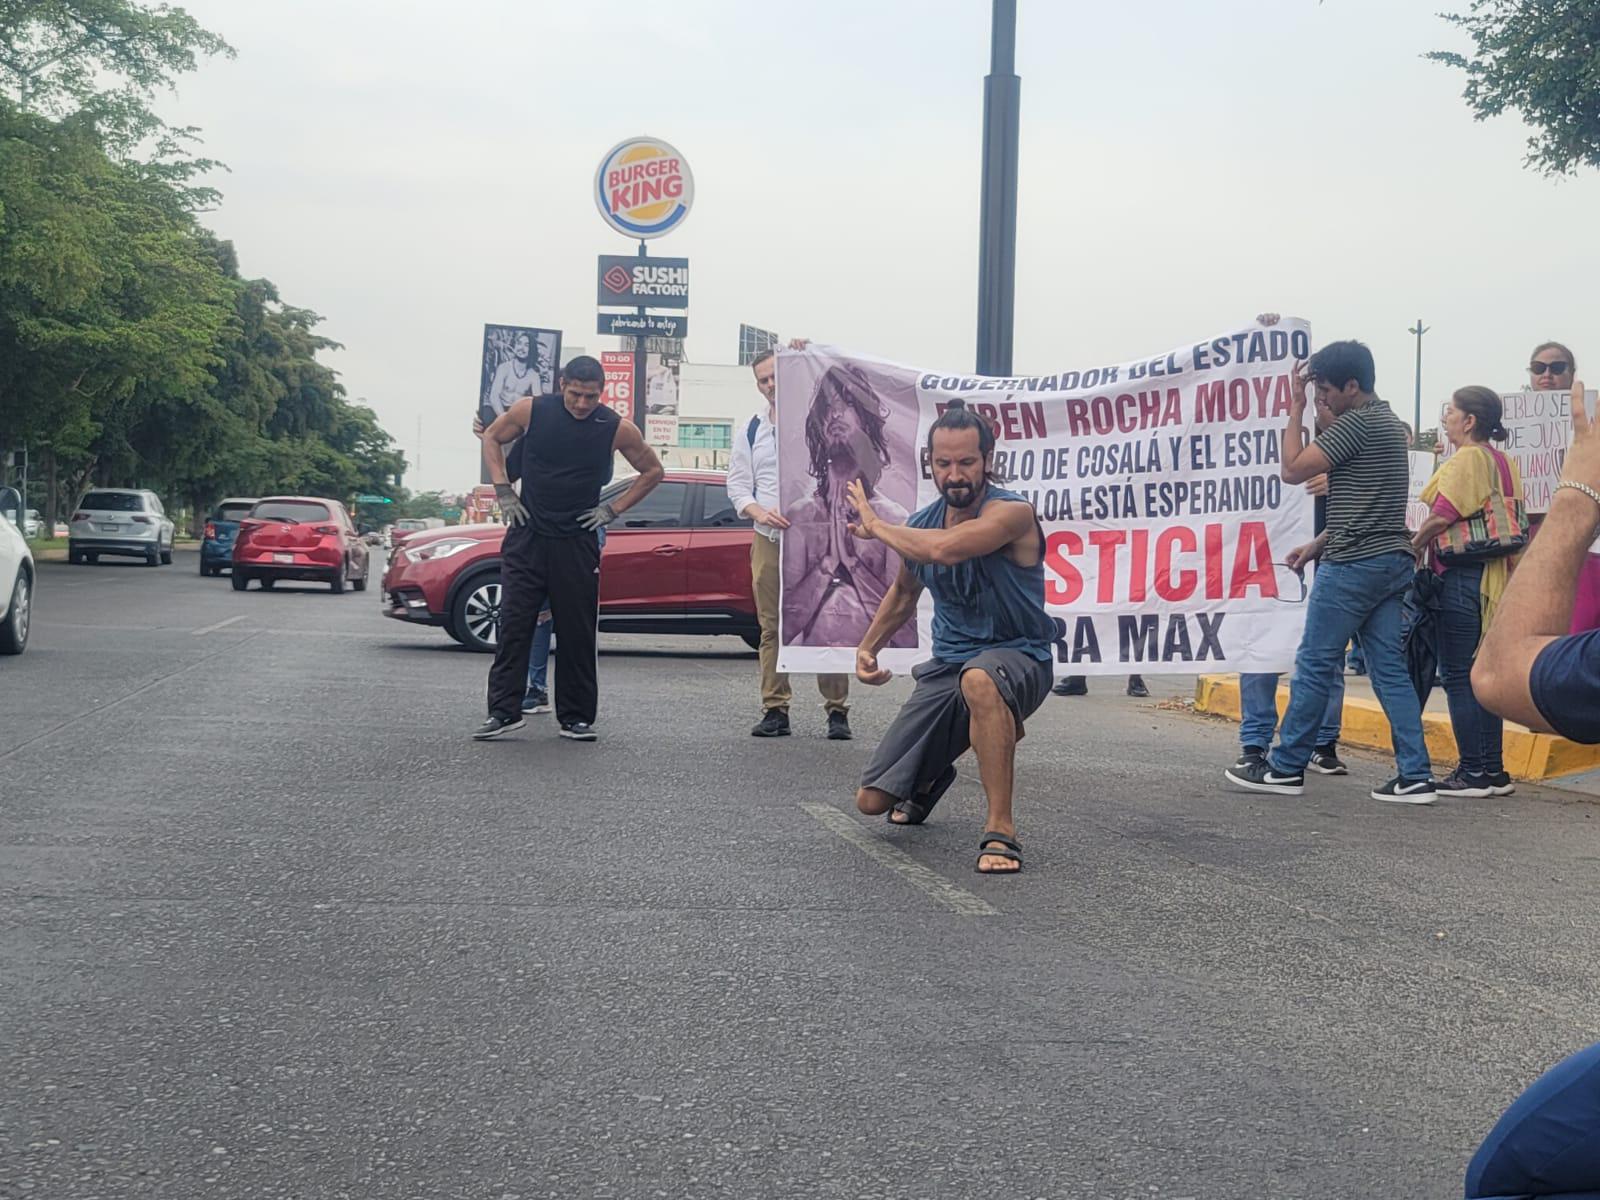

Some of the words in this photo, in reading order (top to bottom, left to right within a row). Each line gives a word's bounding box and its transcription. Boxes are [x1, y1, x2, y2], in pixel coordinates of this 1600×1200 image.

[608, 158, 680, 189] BURGER
[611, 174, 683, 213] KING
[632, 266, 688, 283] SUSHI
[632, 284, 688, 296] FACTORY
[920, 366, 1119, 392] GOBERNADOR
[1129, 355, 1183, 379] DEL
[1193, 329, 1310, 371] ESTADO
[1067, 387, 1183, 436] ROCHA
[1196, 374, 1292, 423] MOYA
[1503, 393, 1545, 420] EBLO
[993, 448, 1035, 481] BLO
[1042, 447, 1069, 480] DE
[1076, 429, 1162, 476] COSALÁ
[1168, 436, 1185, 471] Y
[1190, 434, 1216, 469] EL
[1081, 475, 1137, 520] ESTÁ
[1145, 474, 1281, 518] ESPERANDO
[1045, 521, 1279, 606] STICIA
[1051, 616, 1103, 664] RA
[1117, 612, 1226, 663] MAX
